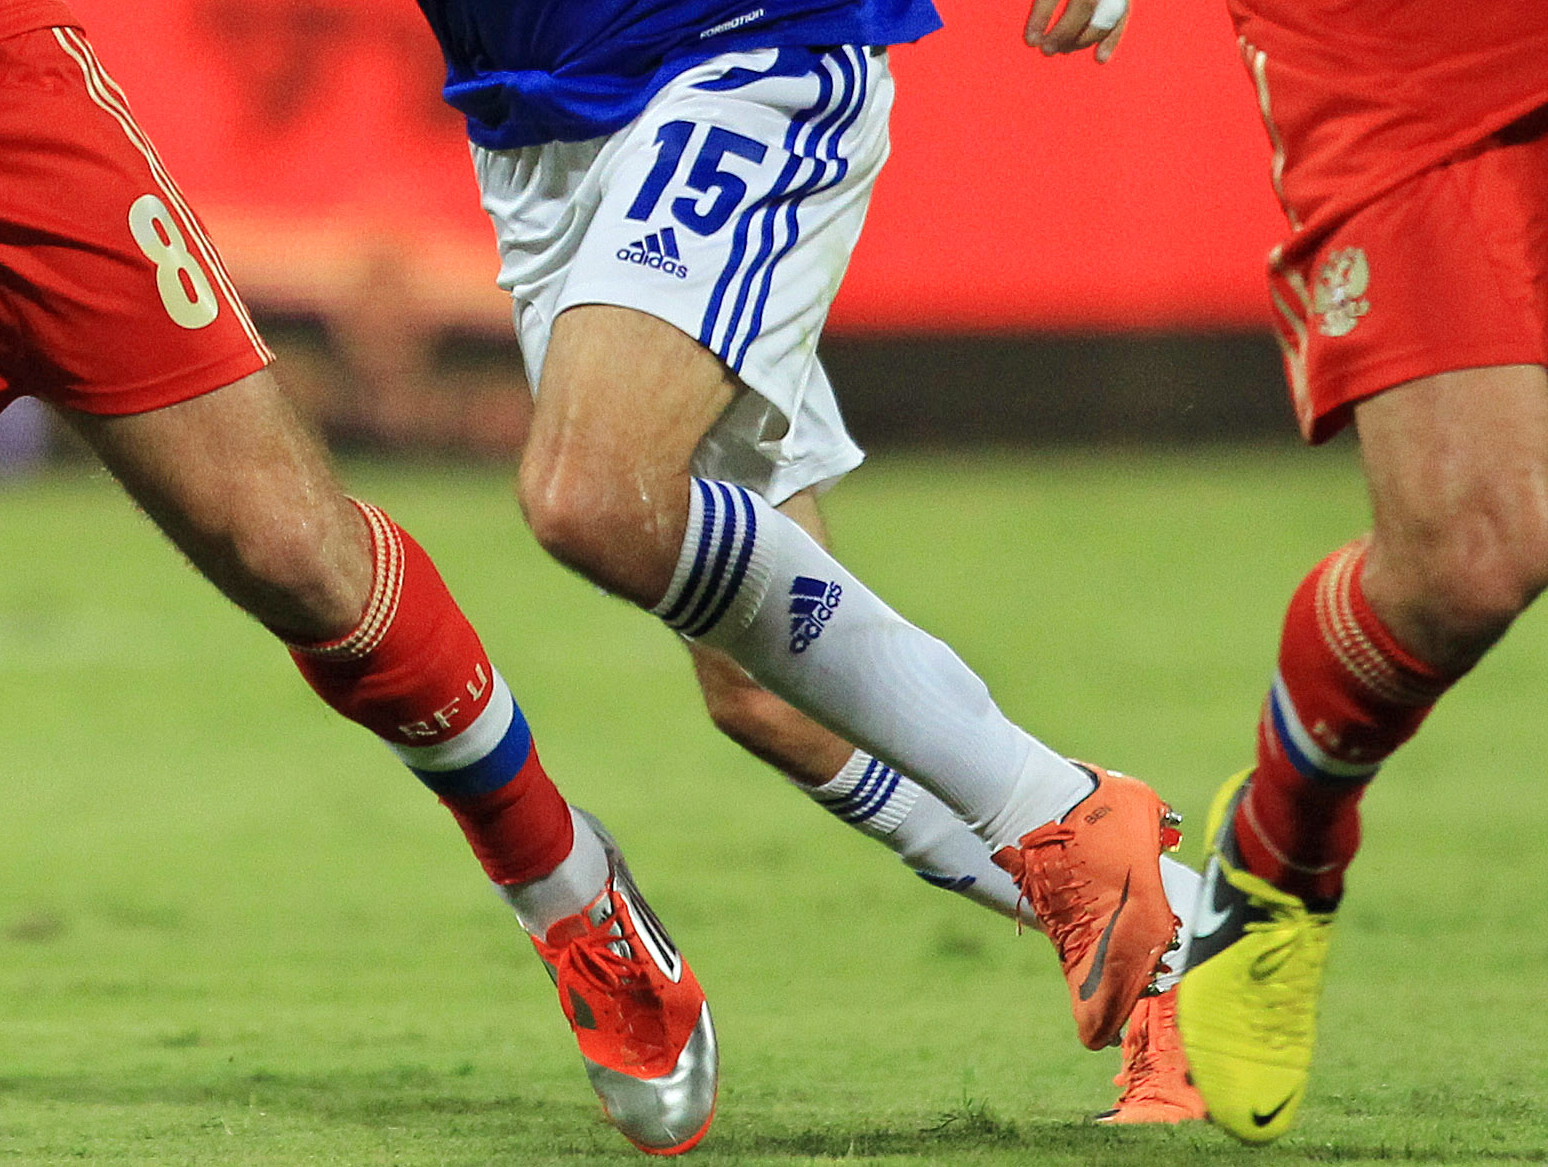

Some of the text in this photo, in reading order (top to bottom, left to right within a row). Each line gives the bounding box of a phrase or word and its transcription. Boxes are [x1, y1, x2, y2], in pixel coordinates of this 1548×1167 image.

[626, 120, 768, 236] 15
[128, 194, 219, 329] 8
[617, 249, 688, 279] adidas
[789, 581, 842, 653] adidas
